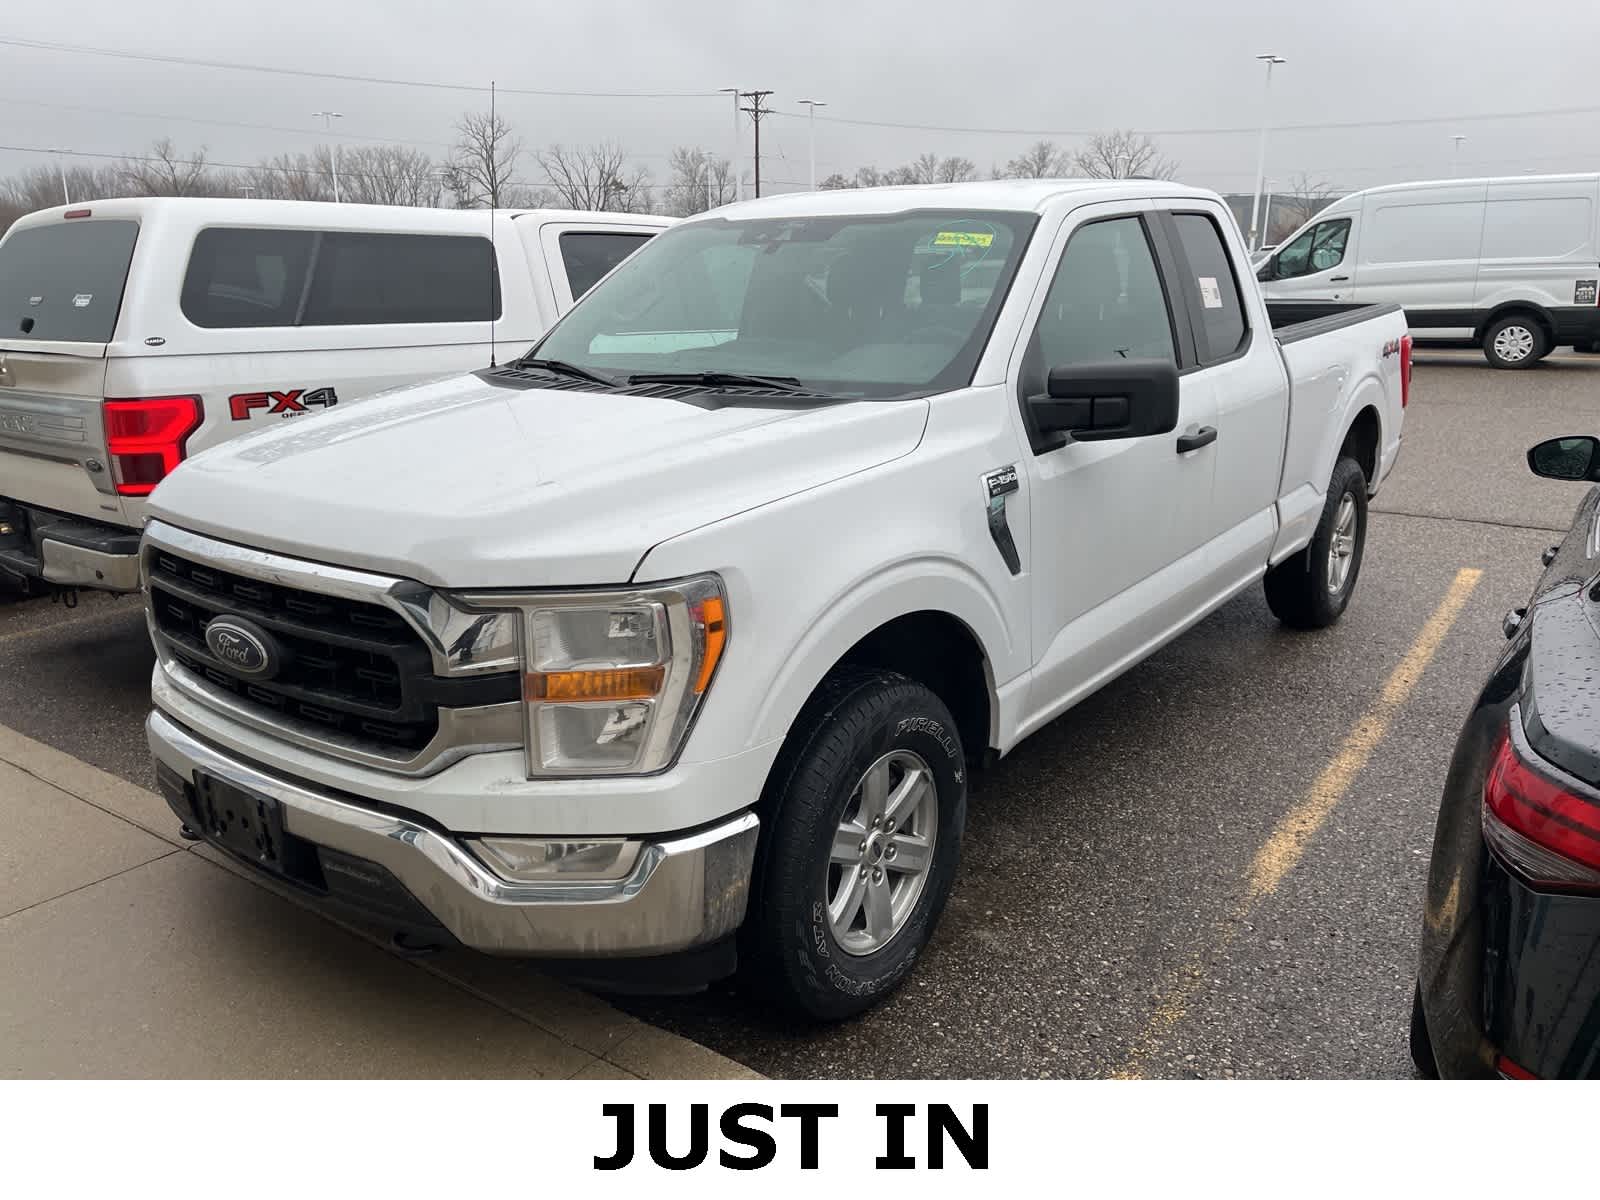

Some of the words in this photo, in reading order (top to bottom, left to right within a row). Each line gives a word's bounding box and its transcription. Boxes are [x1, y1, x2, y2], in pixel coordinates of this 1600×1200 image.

[228, 387, 338, 421] FX4
[217, 632, 249, 663] Ford
[894, 717, 957, 758] PIRELLI
